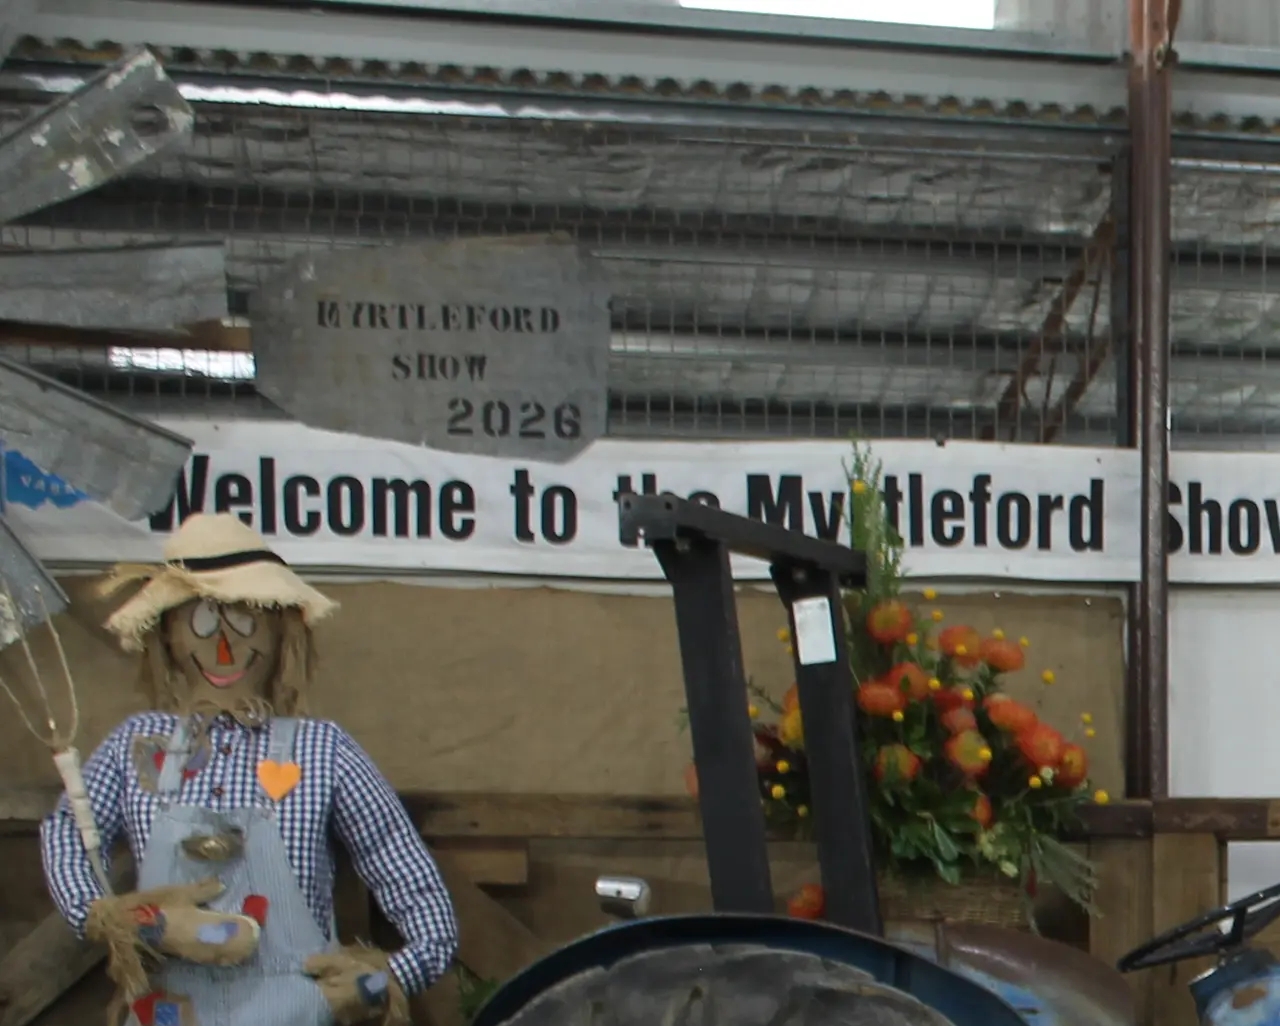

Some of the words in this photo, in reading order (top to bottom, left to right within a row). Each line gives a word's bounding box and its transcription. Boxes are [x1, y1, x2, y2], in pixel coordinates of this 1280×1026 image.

[316, 300, 561, 334] MYRTLEFORD
[391, 353, 488, 381] SHOW
[446, 397, 582, 440] 2026
[149, 454, 477, 541] Welcome
[509, 468, 578, 544] to
[745, 472, 1104, 552] Mytleford
